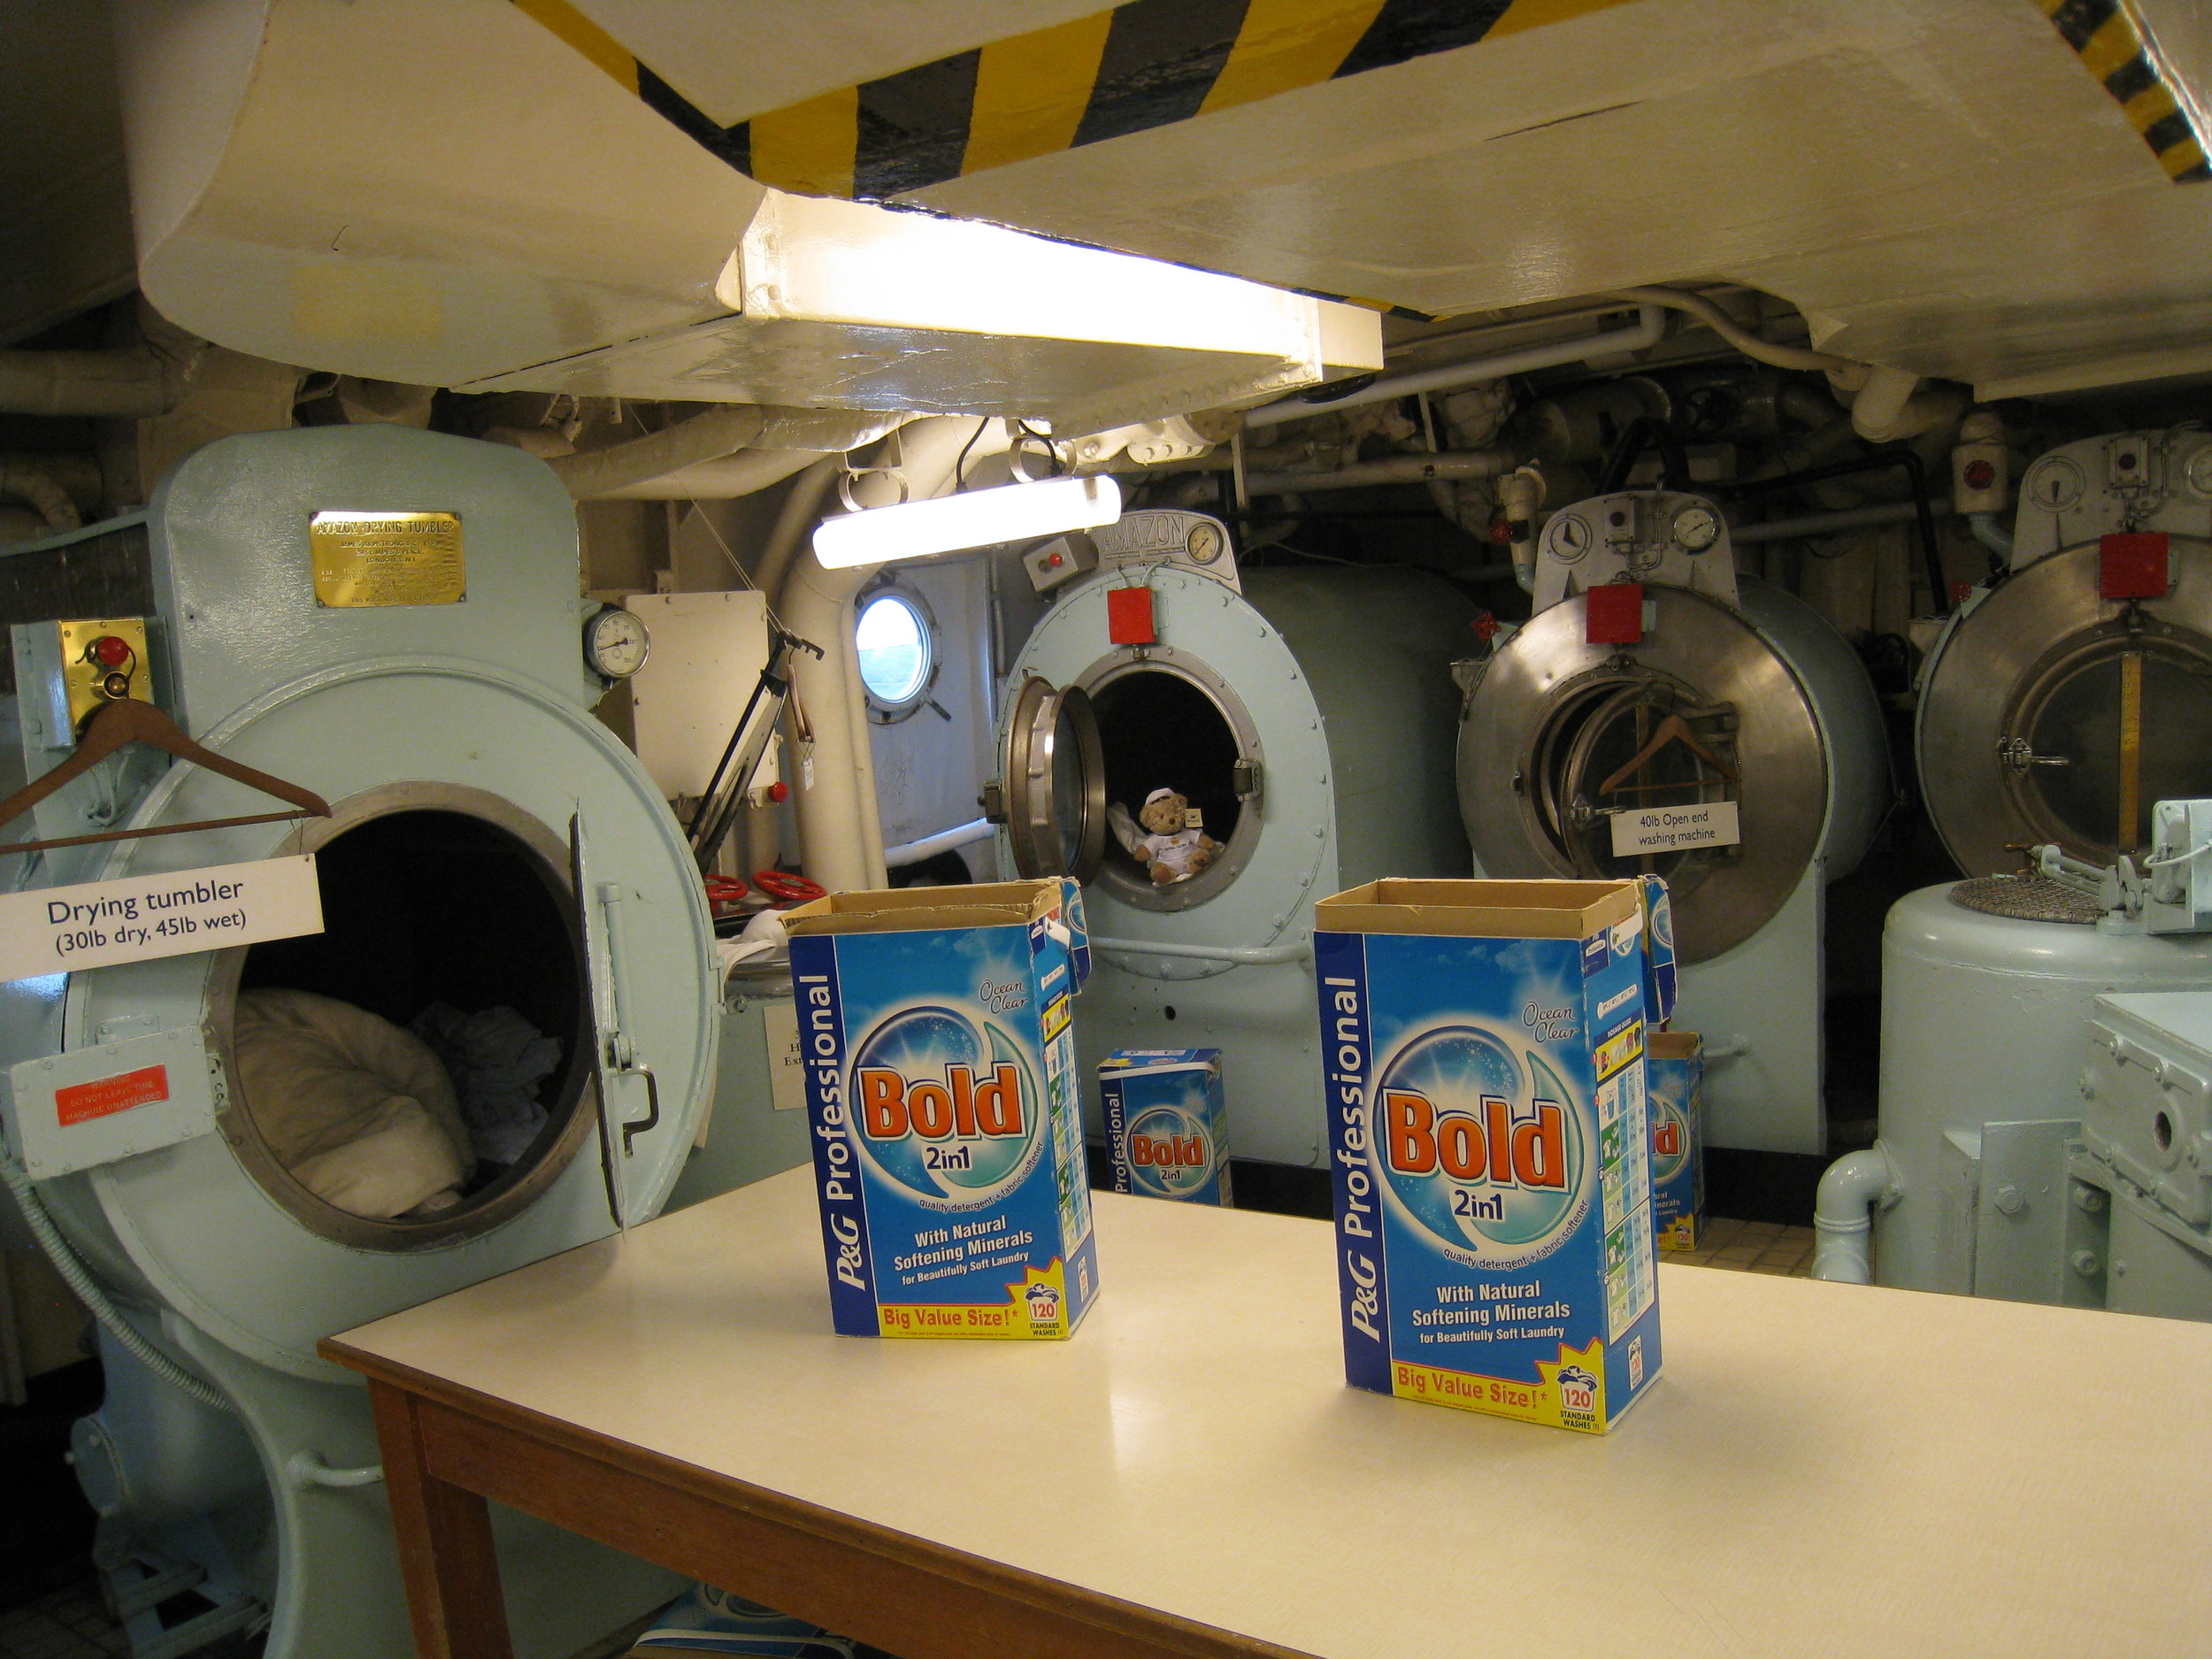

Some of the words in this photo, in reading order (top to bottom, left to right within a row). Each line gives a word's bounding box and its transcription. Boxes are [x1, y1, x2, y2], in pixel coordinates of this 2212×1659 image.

[318, 521, 358, 534] AMAZON
[365, 521, 403, 534] DRYING
[408, 521, 454, 534] TUMBLER
[1104, 516, 1184, 550] AMAZON
[1640, 814, 1660, 827] 40lb
[1663, 813, 1689, 828] Open
[1692, 810, 1709, 823] end
[1639, 833, 1676, 846] washing
[1678, 828, 1716, 841] machine
[47, 896, 139, 926] Drying
[145, 879, 244, 910] tumbler
[56, 929, 107, 957] (30lb
[114, 926, 151, 946] dry,
[155, 917, 197, 937] 45lb
[204, 909, 247, 930] wet)
[979, 979, 1026, 1002] Ocean
[990, 995, 1028, 1015] Clear
[1523, 1001, 1576, 1026] Ocean
[1535, 1021, 1578, 1043] Clear
[71, 1097, 83, 1108] DO
[85, 1093, 104, 1103] NOT
[105, 1087, 132, 1099] LEAVE
[134, 1080, 154, 1091] THIS
[90, 1075, 131, 1090] WARNING
[799, 975, 855, 1202] Professional
[65, 1104, 105, 1120] MACHINE
[107, 1090, 163, 1110] UNATTENDED
[857, 1063, 1027, 1141] Bold
[1324, 977, 1373, 1239] Professional
[1104, 1093, 1128, 1193] Professional
[1133, 1134, 1205, 1168] Bold
[1383, 1089, 1570, 1194] Bold
[926, 1146, 971, 1170] 2in1
[918, 1198, 949, 1214] quality
[950, 1196, 994, 1212] detergent
[1001, 1177, 1024, 1197] fabric
[1022, 1141, 1045, 1178] softener
[1161, 1170, 1180, 1180] 2in1
[1454, 1189, 1503, 1220] 2in1
[914, 1228, 949, 1248] With
[952, 1215, 1007, 1240] Natural
[1443, 1248, 1477, 1268] quality
[1479, 1257, 1528, 1271] detergent
[1536, 1237, 1563, 1259] fabric
[1562, 1199, 1589, 1240] softener
[831, 1213, 866, 1292] P&G
[894, 1245, 964, 1271] Softening
[967, 1230, 1033, 1256] Minerals
[902, 1275, 917, 1286] for
[917, 1263, 968, 1283] Beautifully
[970, 1258, 990, 1271] Soft
[992, 1251, 1029, 1268] Laundry
[1348, 1249, 1381, 1343] P&G
[1436, 1285, 1474, 1303] With
[1479, 1280, 1540, 1302] Natural
[883, 1309, 910, 1329] Big
[914, 1309, 962, 1326] Value
[1032, 1302, 1055, 1318] 120
[1412, 1307, 1490, 1326] Softening
[1494, 1301, 1571, 1322] Minerals
[1419, 1333, 1434, 1343] for
[1437, 1329, 1494, 1343] Beautifully
[1496, 1327, 1518, 1340] Soft
[1521, 1325, 1564, 1339] Laundry
[1397, 1366, 1425, 1394] Big
[1432, 1372, 1484, 1400] Value
[1563, 1388, 1591, 1408] 120
[1560, 1410, 1596, 1423] STANDARD
[1563, 1418, 1592, 1430] WASHES
